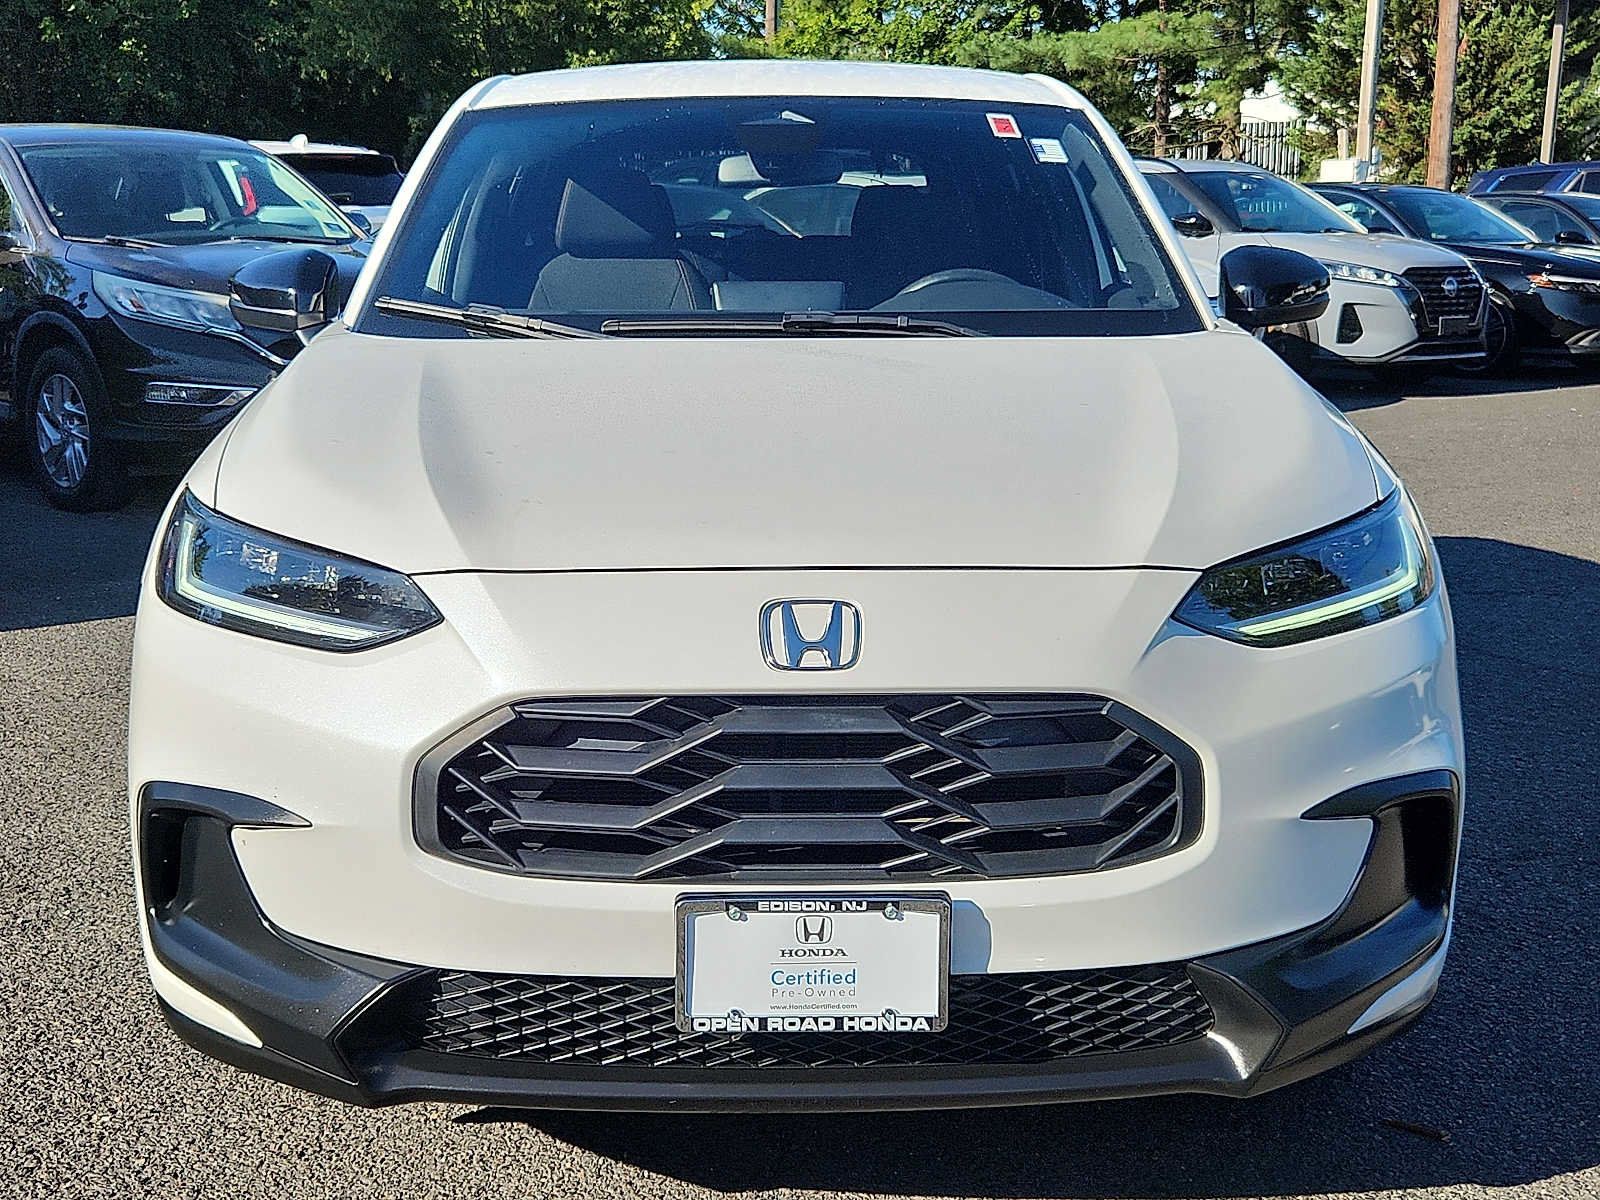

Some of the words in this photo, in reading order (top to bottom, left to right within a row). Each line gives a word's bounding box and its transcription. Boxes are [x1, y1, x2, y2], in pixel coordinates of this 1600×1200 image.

[757, 900, 836, 912] EDISON,
[841, 900, 868, 912] NJ
[780, 948, 848, 958] HONDA
[770, 968, 857, 986] Certified
[771, 987, 856, 998] Pre-Owned
[693, 1016, 760, 1032] OPEN
[767, 1016, 836, 1032] ROAD
[843, 1016, 931, 1032] HONDA
